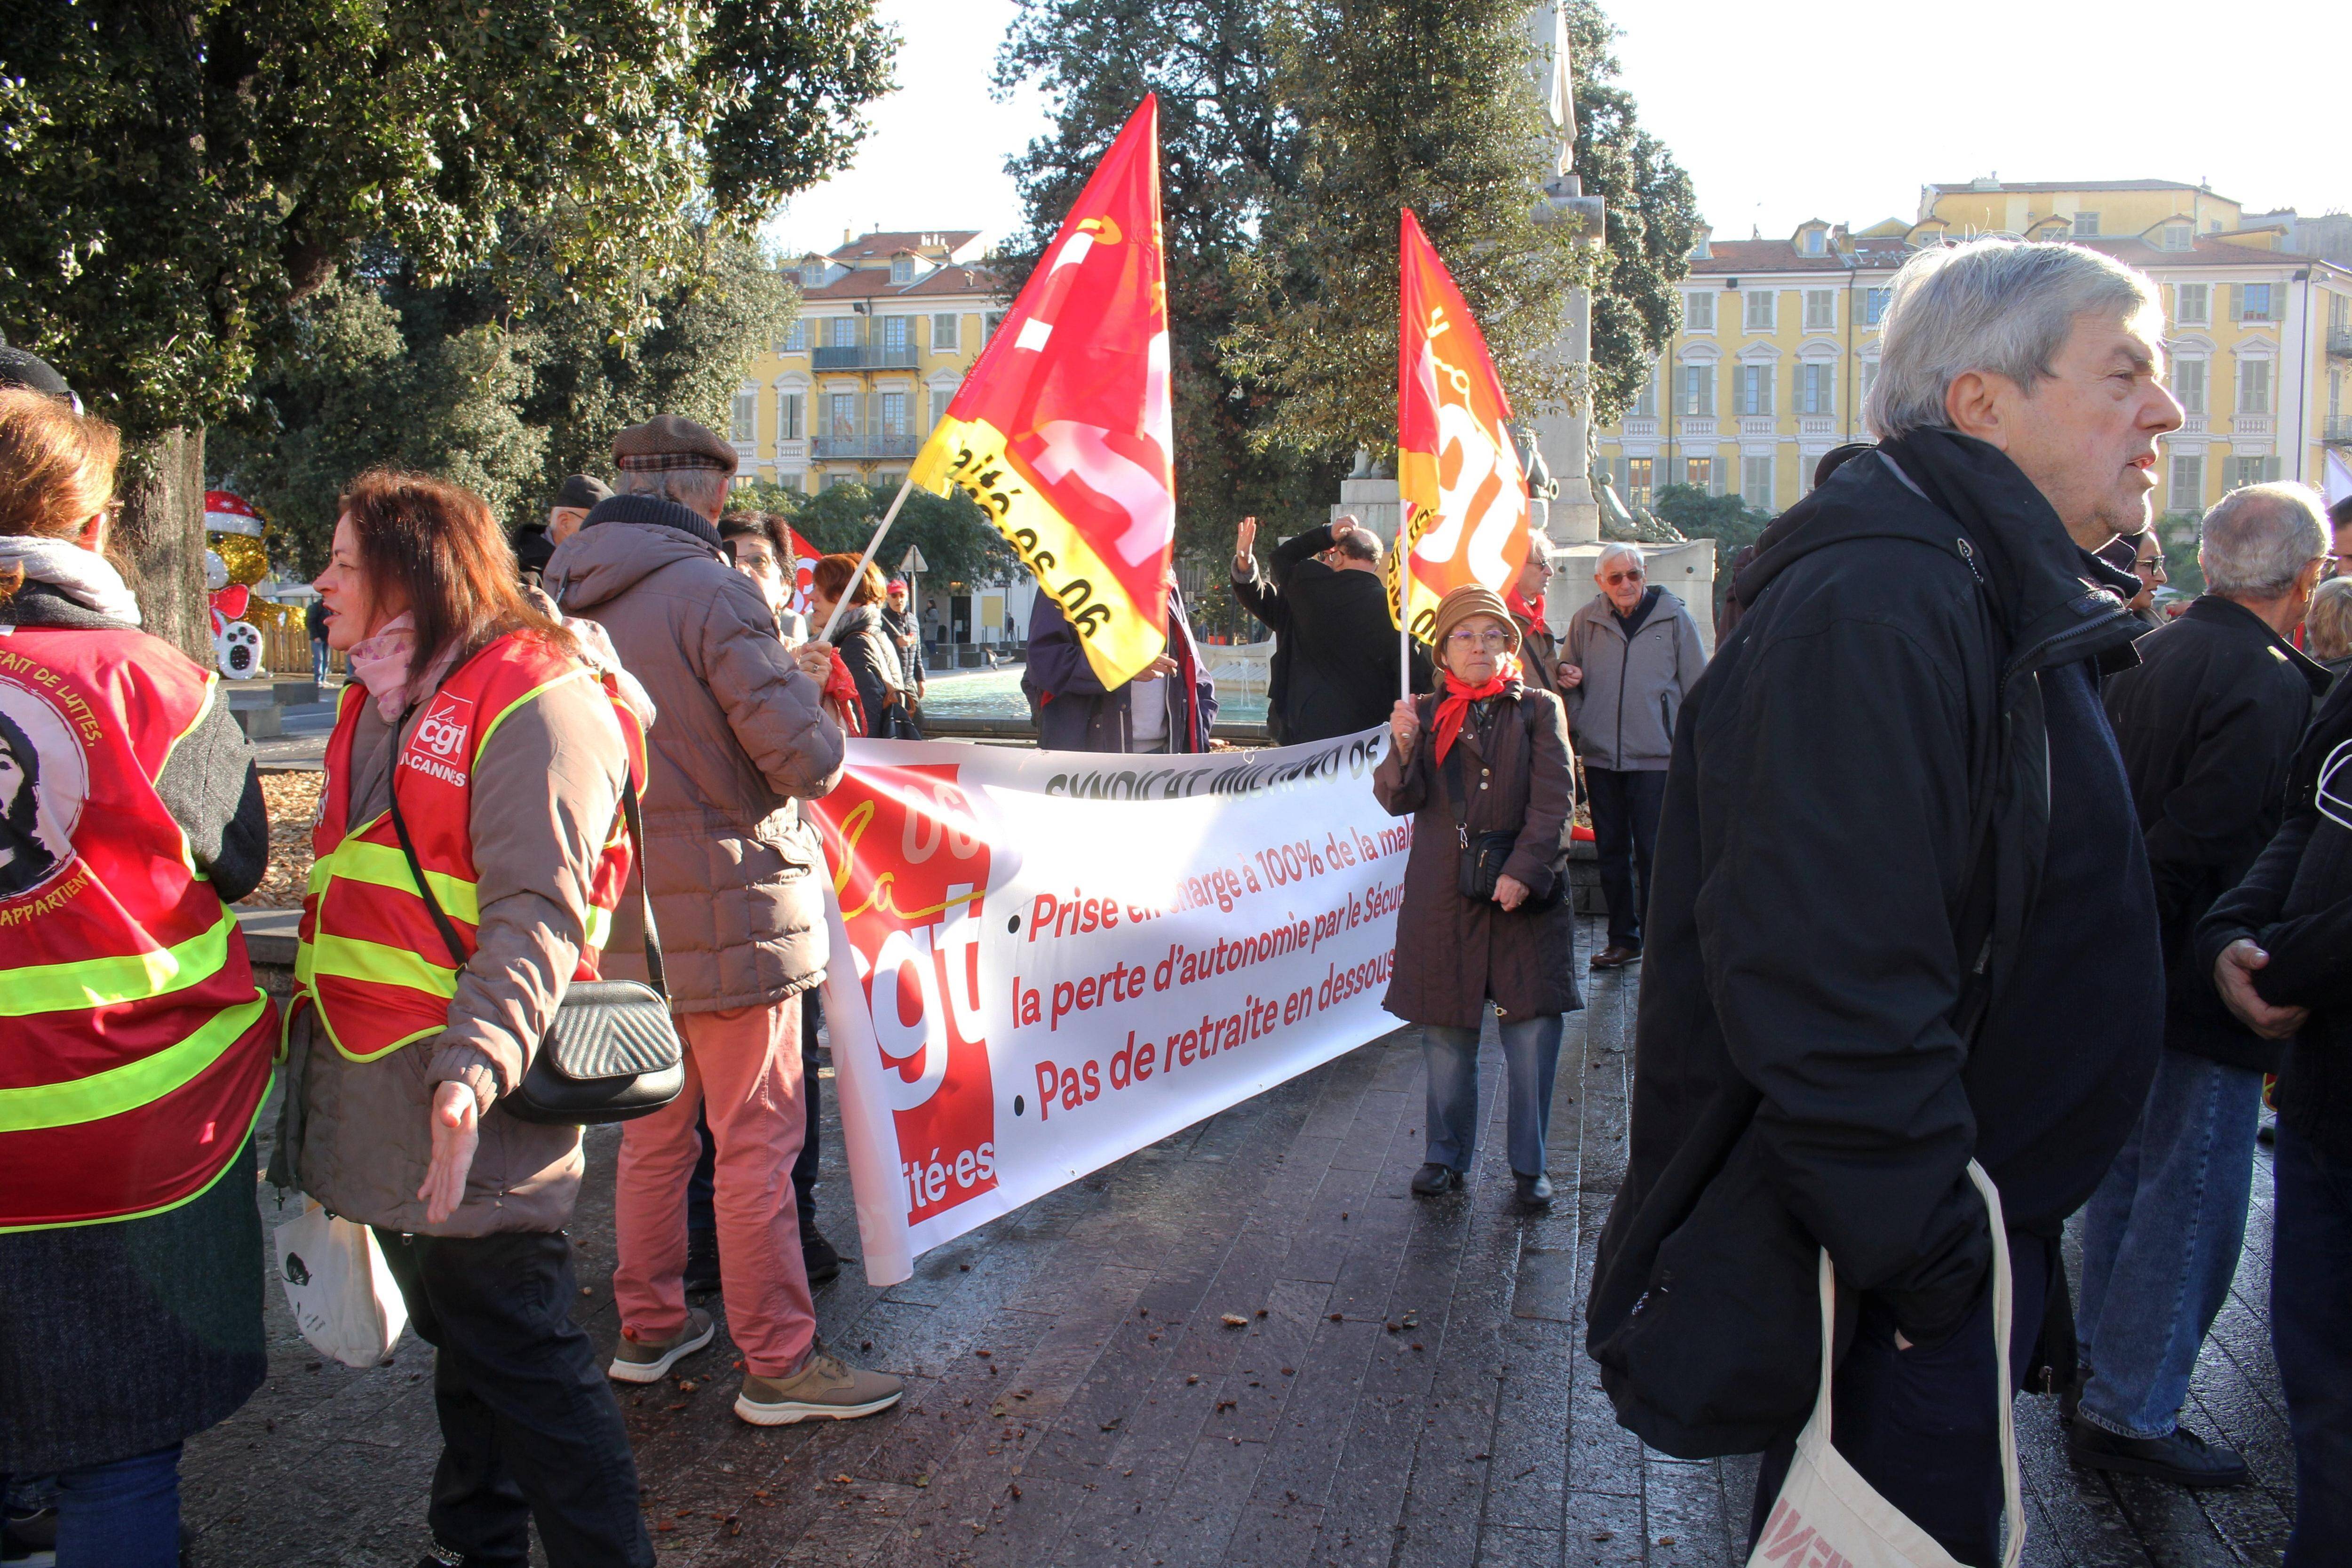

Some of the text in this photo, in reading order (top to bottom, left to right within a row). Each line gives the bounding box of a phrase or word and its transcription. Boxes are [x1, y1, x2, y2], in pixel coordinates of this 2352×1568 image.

[33, 667, 62, 687] DE
[56, 685, 103, 747] LUTTES,
[419, 719, 467, 755] cgt
[429, 705, 466, 728] la
[411, 755, 467, 787] CANNS
[1349, 734, 1381, 780] DE
[901, 784, 980, 864] 06
[1028, 886, 1119, 942] Prise
[1236, 852, 1262, 893] à
[1255, 839, 1325, 888] 100%
[1326, 832, 1356, 871] de
[1350, 826, 1379, 862] la
[850, 883, 989, 1111] gt
[1012, 976, 1041, 1029] la
[1050, 961, 1146, 1032] perte
[1153, 911, 1310, 992] d'autonomie
[1311, 906, 1345, 955] par
[1346, 891, 1361, 931] le
[1035, 948, 1396, 1122] Pas de retraite en dessous
